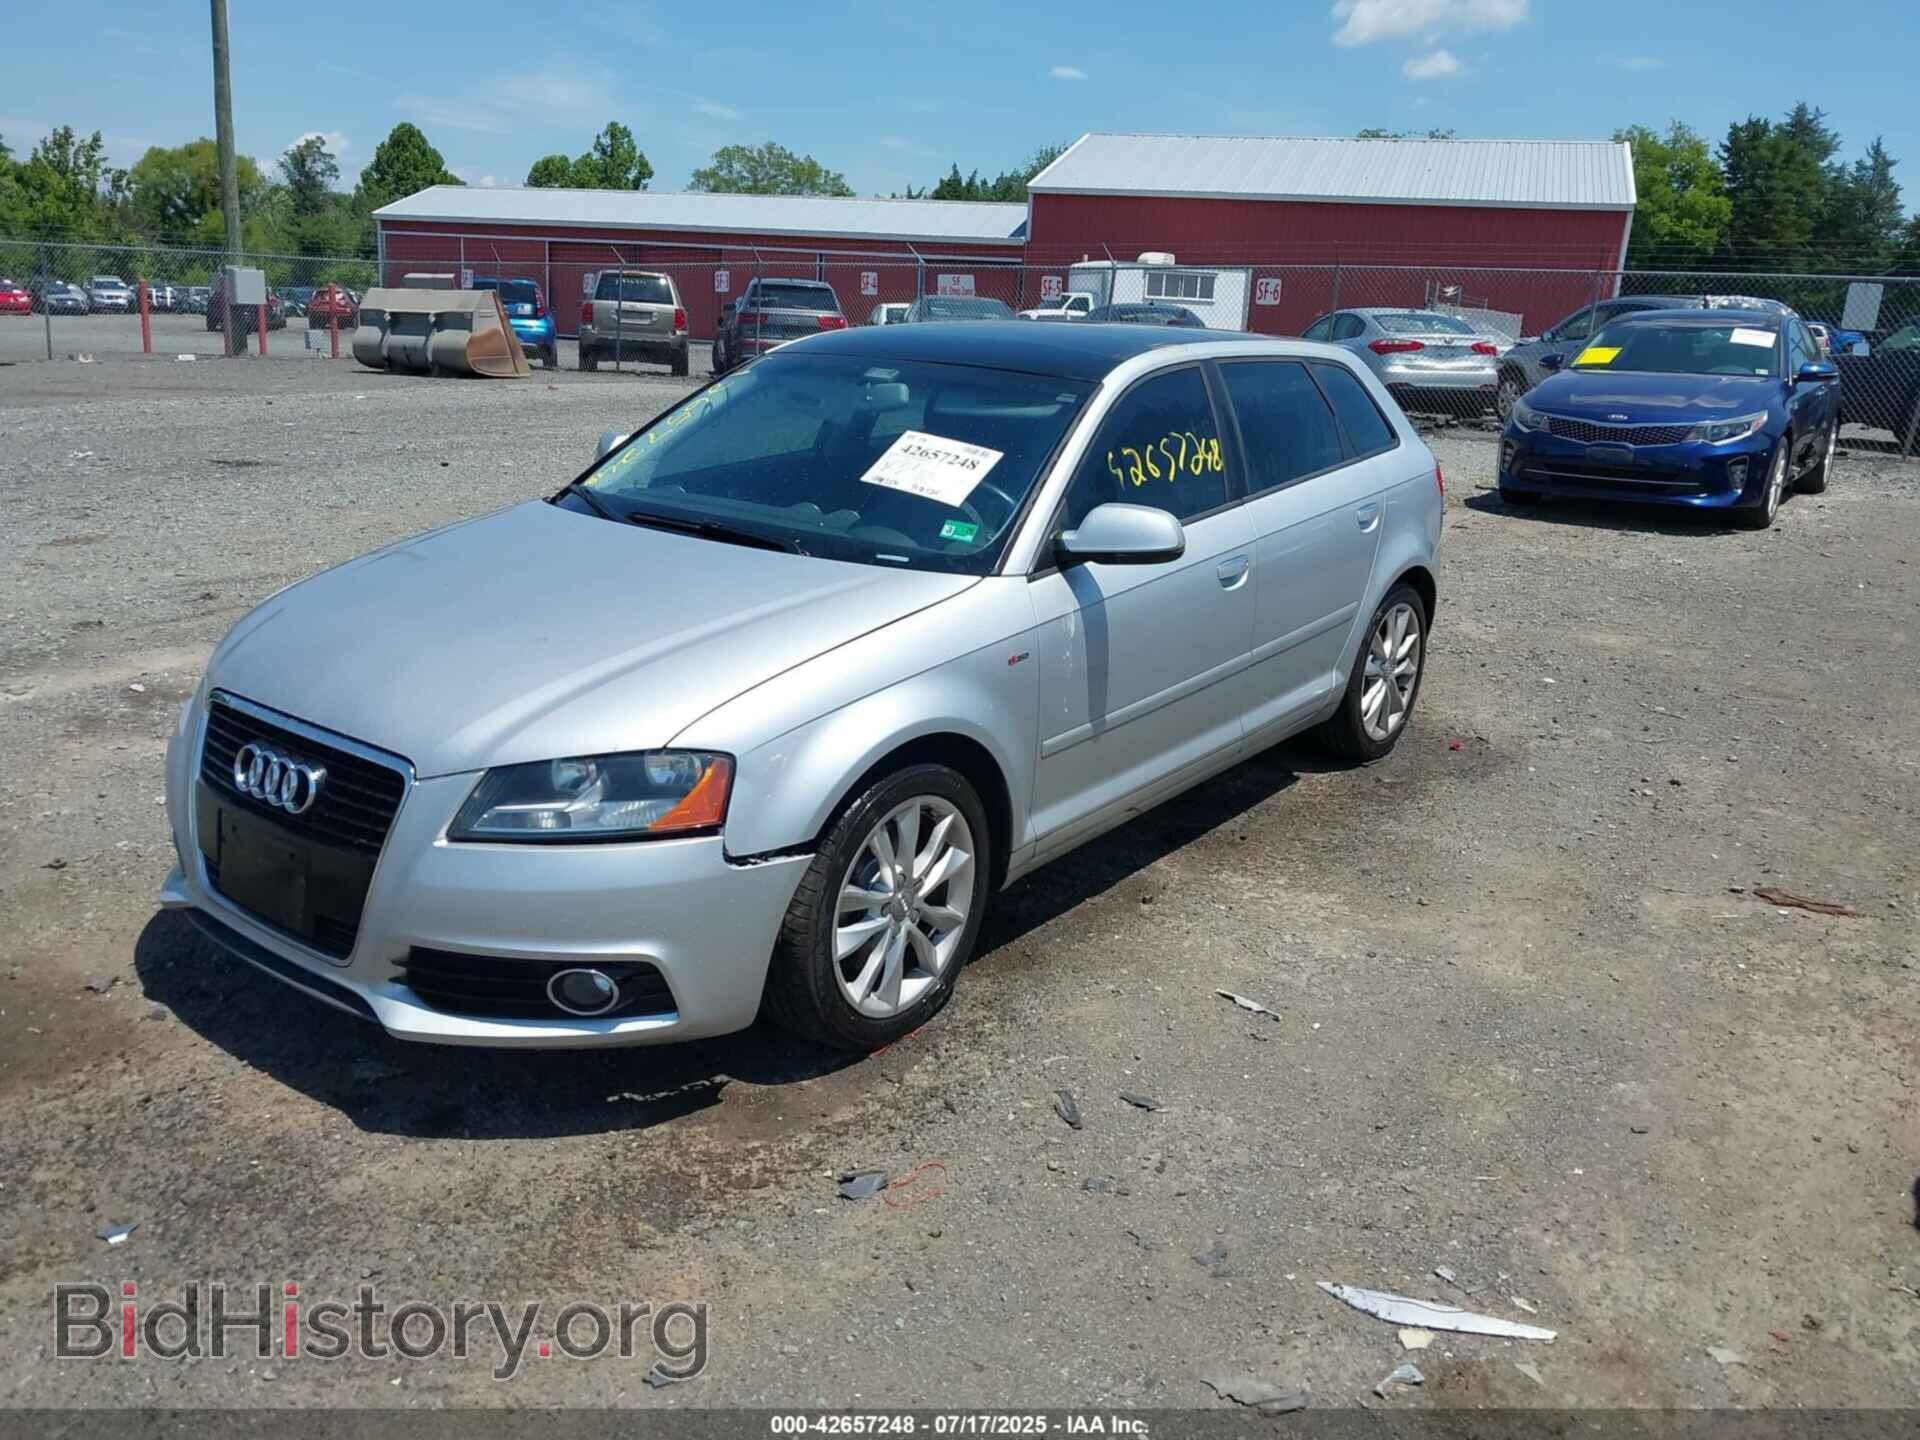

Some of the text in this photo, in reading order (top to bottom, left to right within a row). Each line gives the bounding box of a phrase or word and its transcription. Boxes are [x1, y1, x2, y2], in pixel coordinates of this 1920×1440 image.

[1043, 279, 1061, 297] SF-5
[1257, 280, 1280, 301] SF-6
[901, 444, 980, 470] 42657248
[1107, 432, 1224, 490] 42657248
